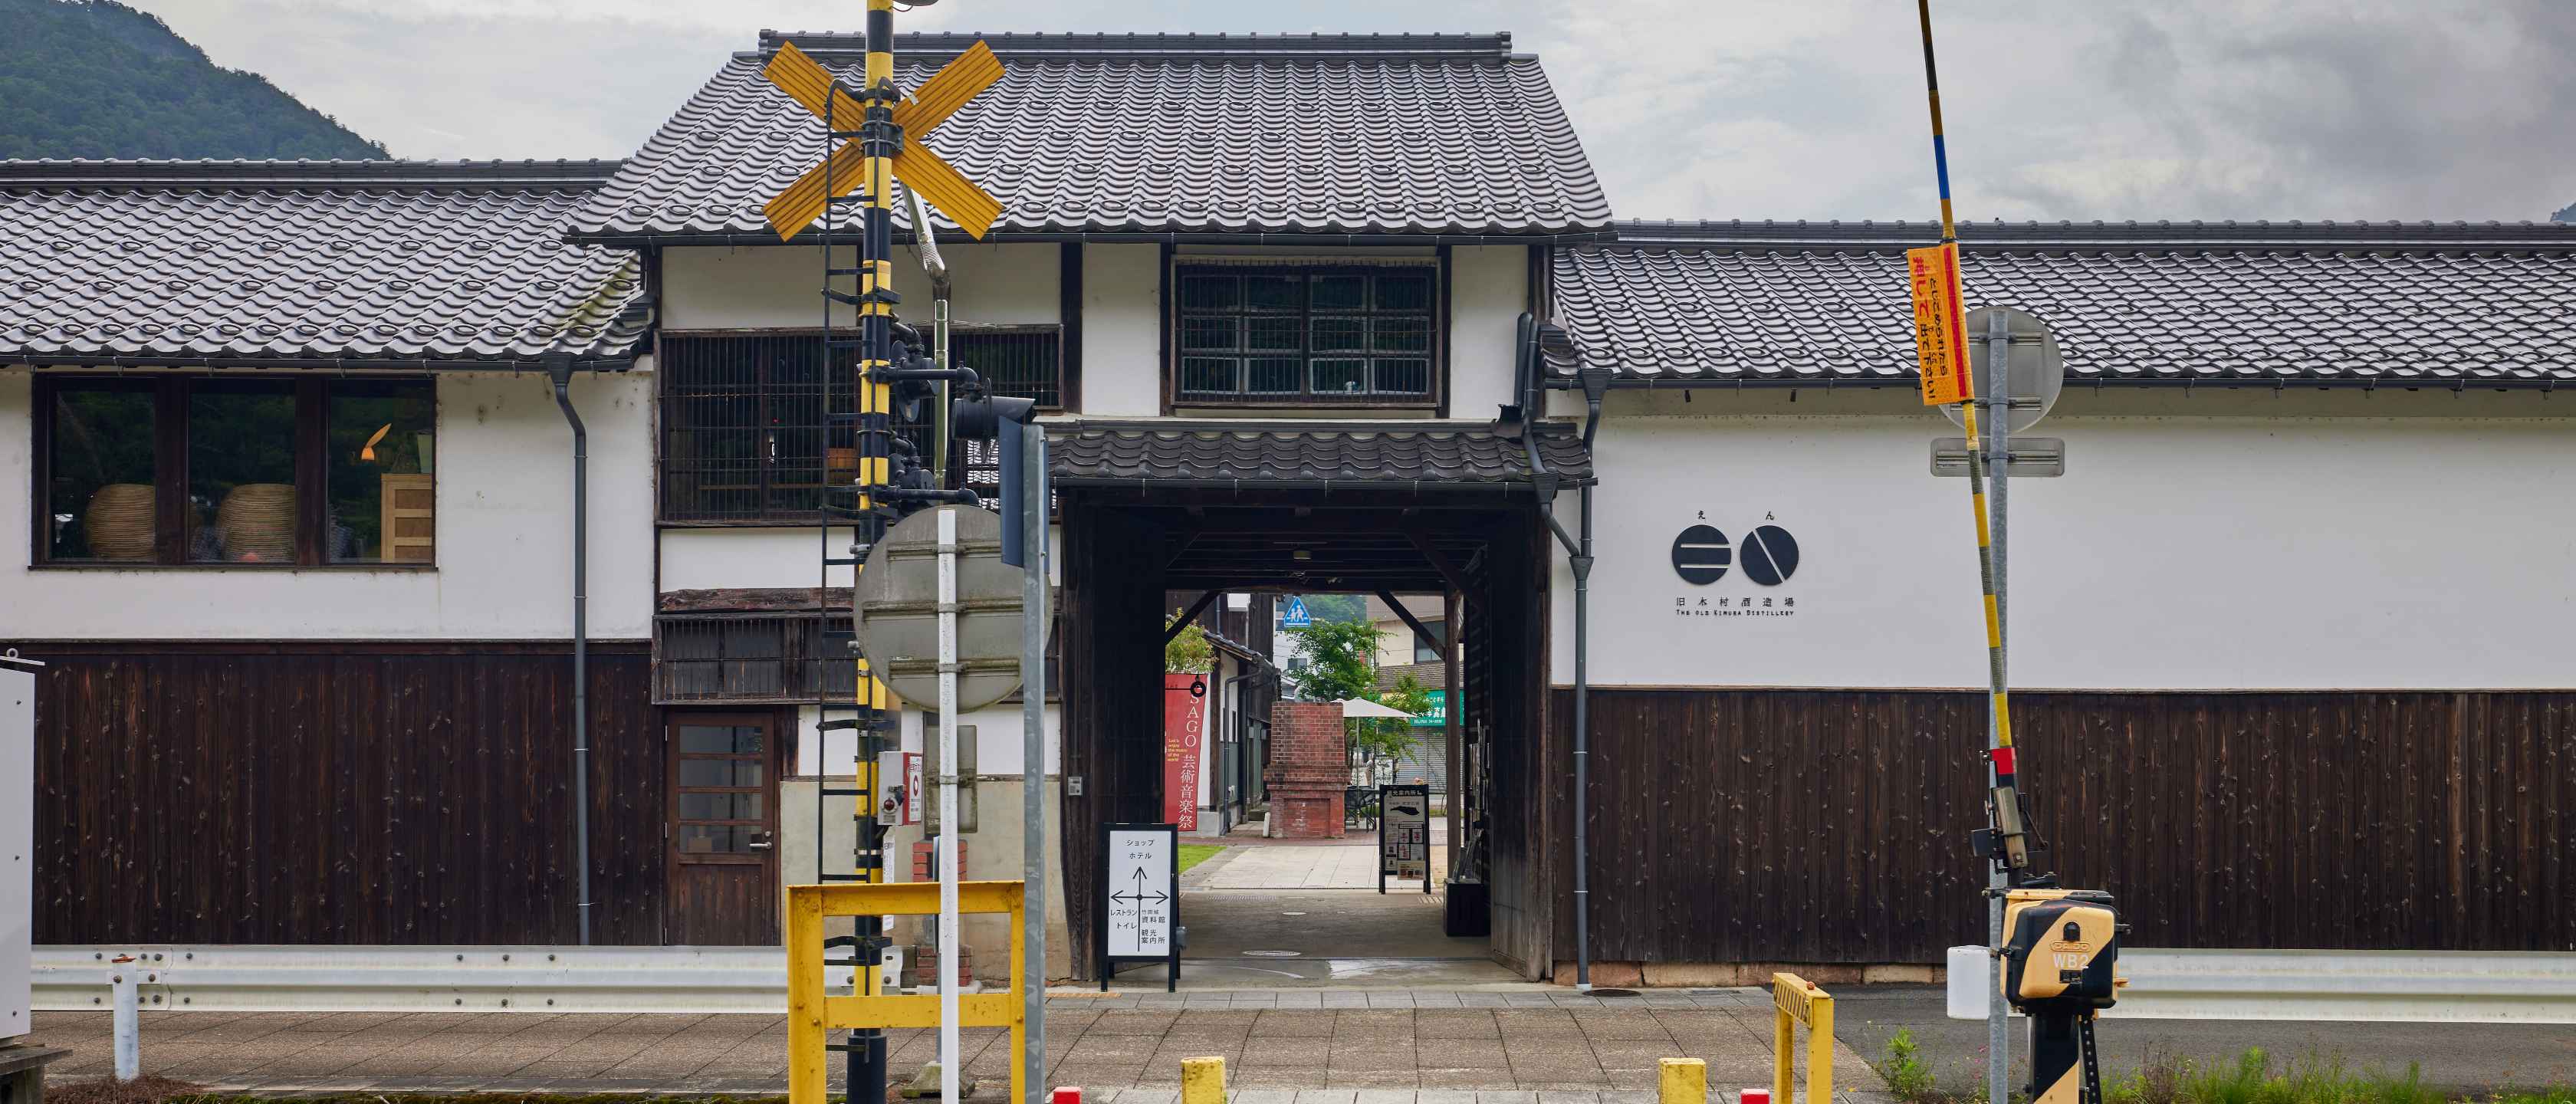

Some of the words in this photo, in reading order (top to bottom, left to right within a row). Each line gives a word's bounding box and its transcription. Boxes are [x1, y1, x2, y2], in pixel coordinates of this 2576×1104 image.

[1930, 278, 1947, 376] とじこめられたら
[1677, 596, 1794, 607] 旧木村酒造場
[1178, 754, 1196, 829] 芸術音楽祭
[2053, 954, 2089, 968] WB2
